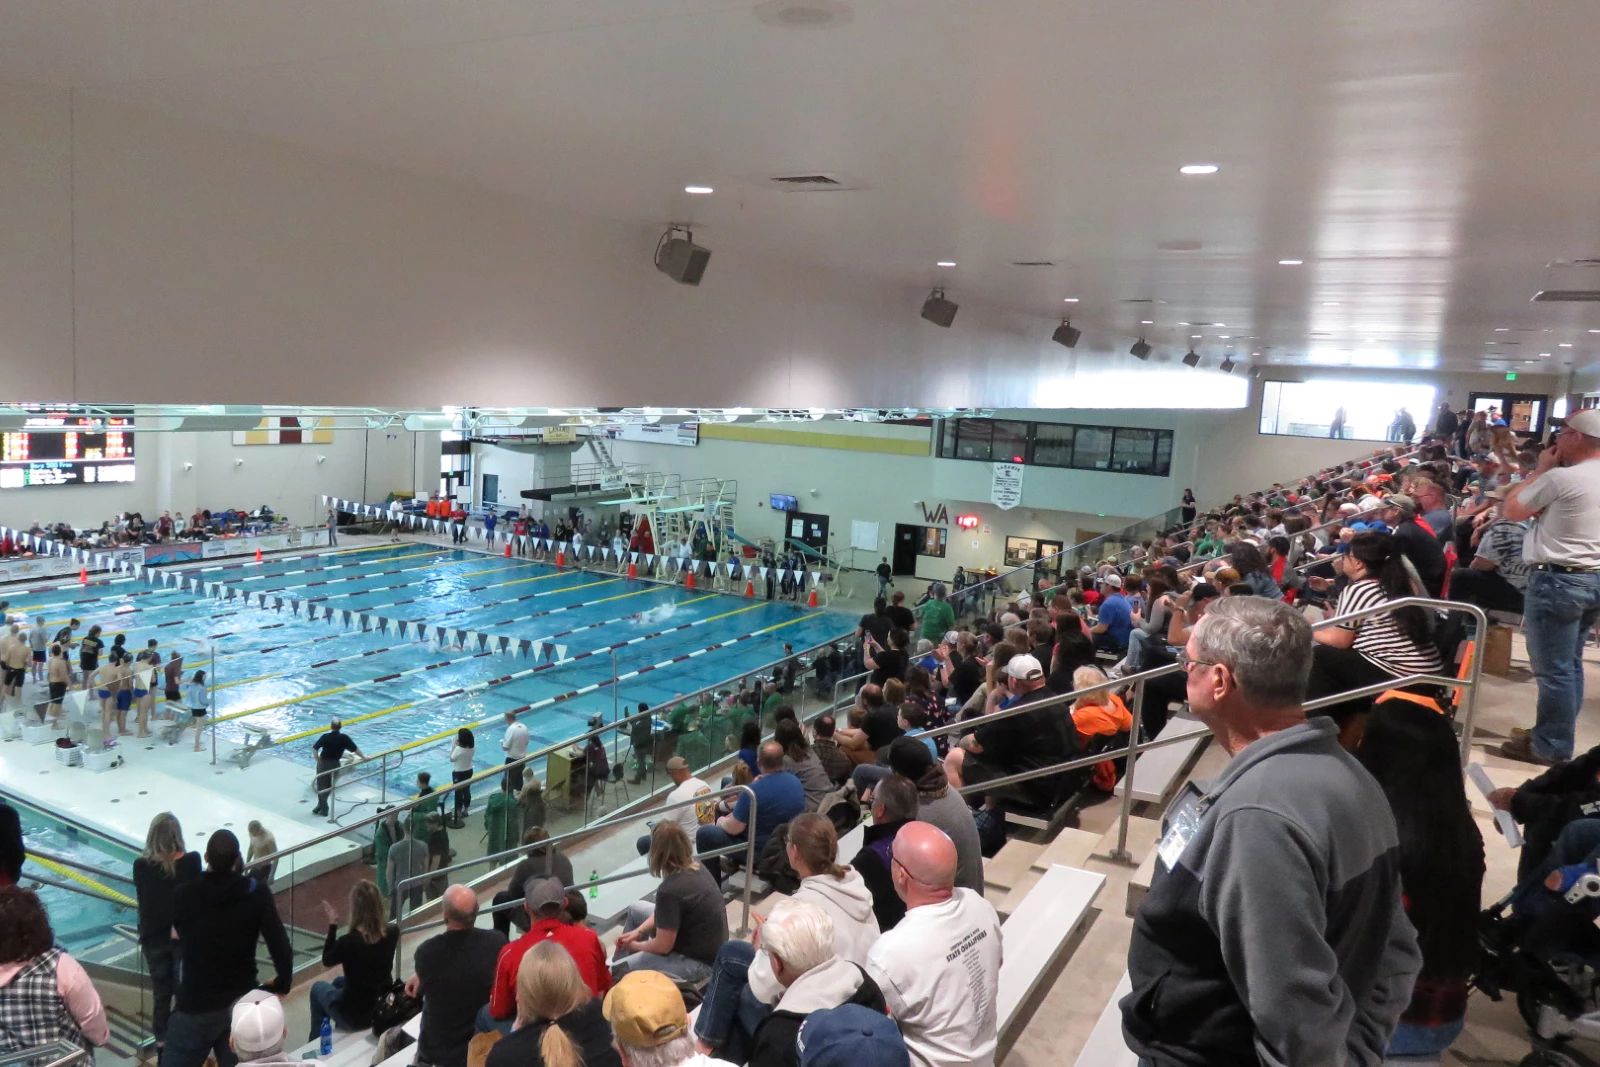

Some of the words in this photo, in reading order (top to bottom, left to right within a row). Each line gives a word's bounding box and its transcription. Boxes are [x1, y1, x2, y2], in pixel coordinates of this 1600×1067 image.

[921, 501, 949, 525] WA
[946, 949, 961, 962] STATE
[961, 930, 987, 952] QUALIFIERS
